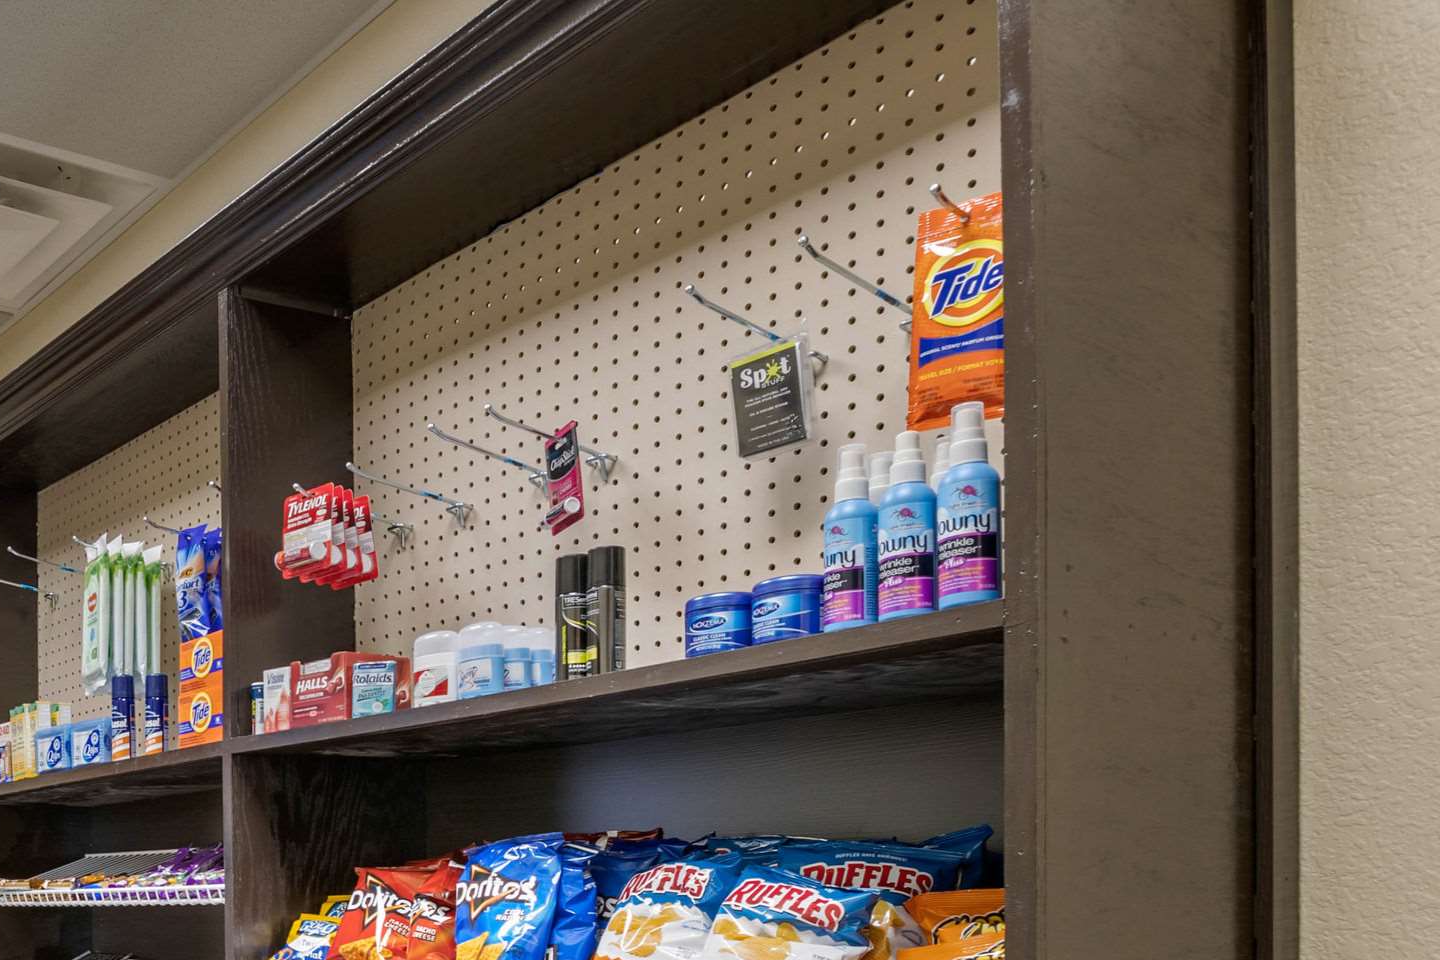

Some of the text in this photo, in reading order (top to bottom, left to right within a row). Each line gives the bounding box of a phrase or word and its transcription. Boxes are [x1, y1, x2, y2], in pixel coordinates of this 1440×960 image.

[930, 256, 1004, 319] Tide
[287, 494, 329, 518] TYLENOL
[937, 513, 991, 534] owny
[880, 534, 928, 554] owny
[880, 566, 915, 580] eleaser
[193, 647, 211, 669] Tide
[296, 676, 329, 695] HALLS
[353, 671, 392, 684] Rolaids
[192, 701, 210, 724] Tide
[456, 876, 536, 905] Doritos
[619, 863, 712, 901] RUFFLES
[801, 861, 934, 897] RUFFLES
[724, 878, 844, 933] RUFFLES
